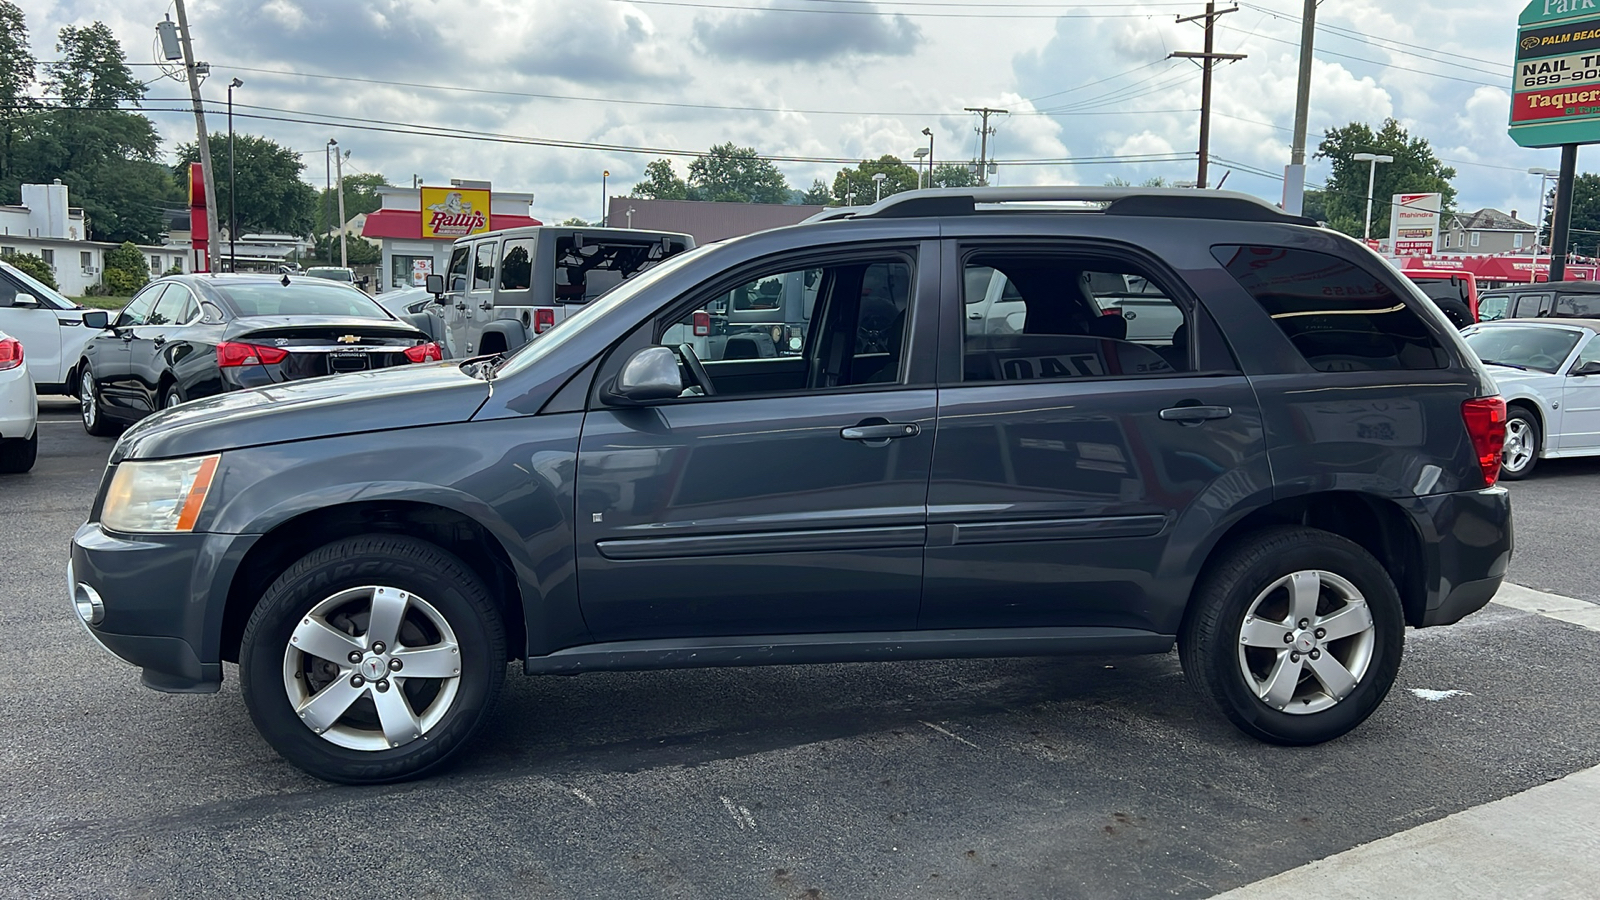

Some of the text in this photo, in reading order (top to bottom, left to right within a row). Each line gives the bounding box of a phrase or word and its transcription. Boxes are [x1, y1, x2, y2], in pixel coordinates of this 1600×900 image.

[1541, 28, 1600, 46] PALM BEAC
[1522, 60, 1571, 77] NAIL
[1524, 69, 1600, 87] 689-90
[1527, 89, 1600, 109] Taquer
[428, 210, 486, 235] Rally's
